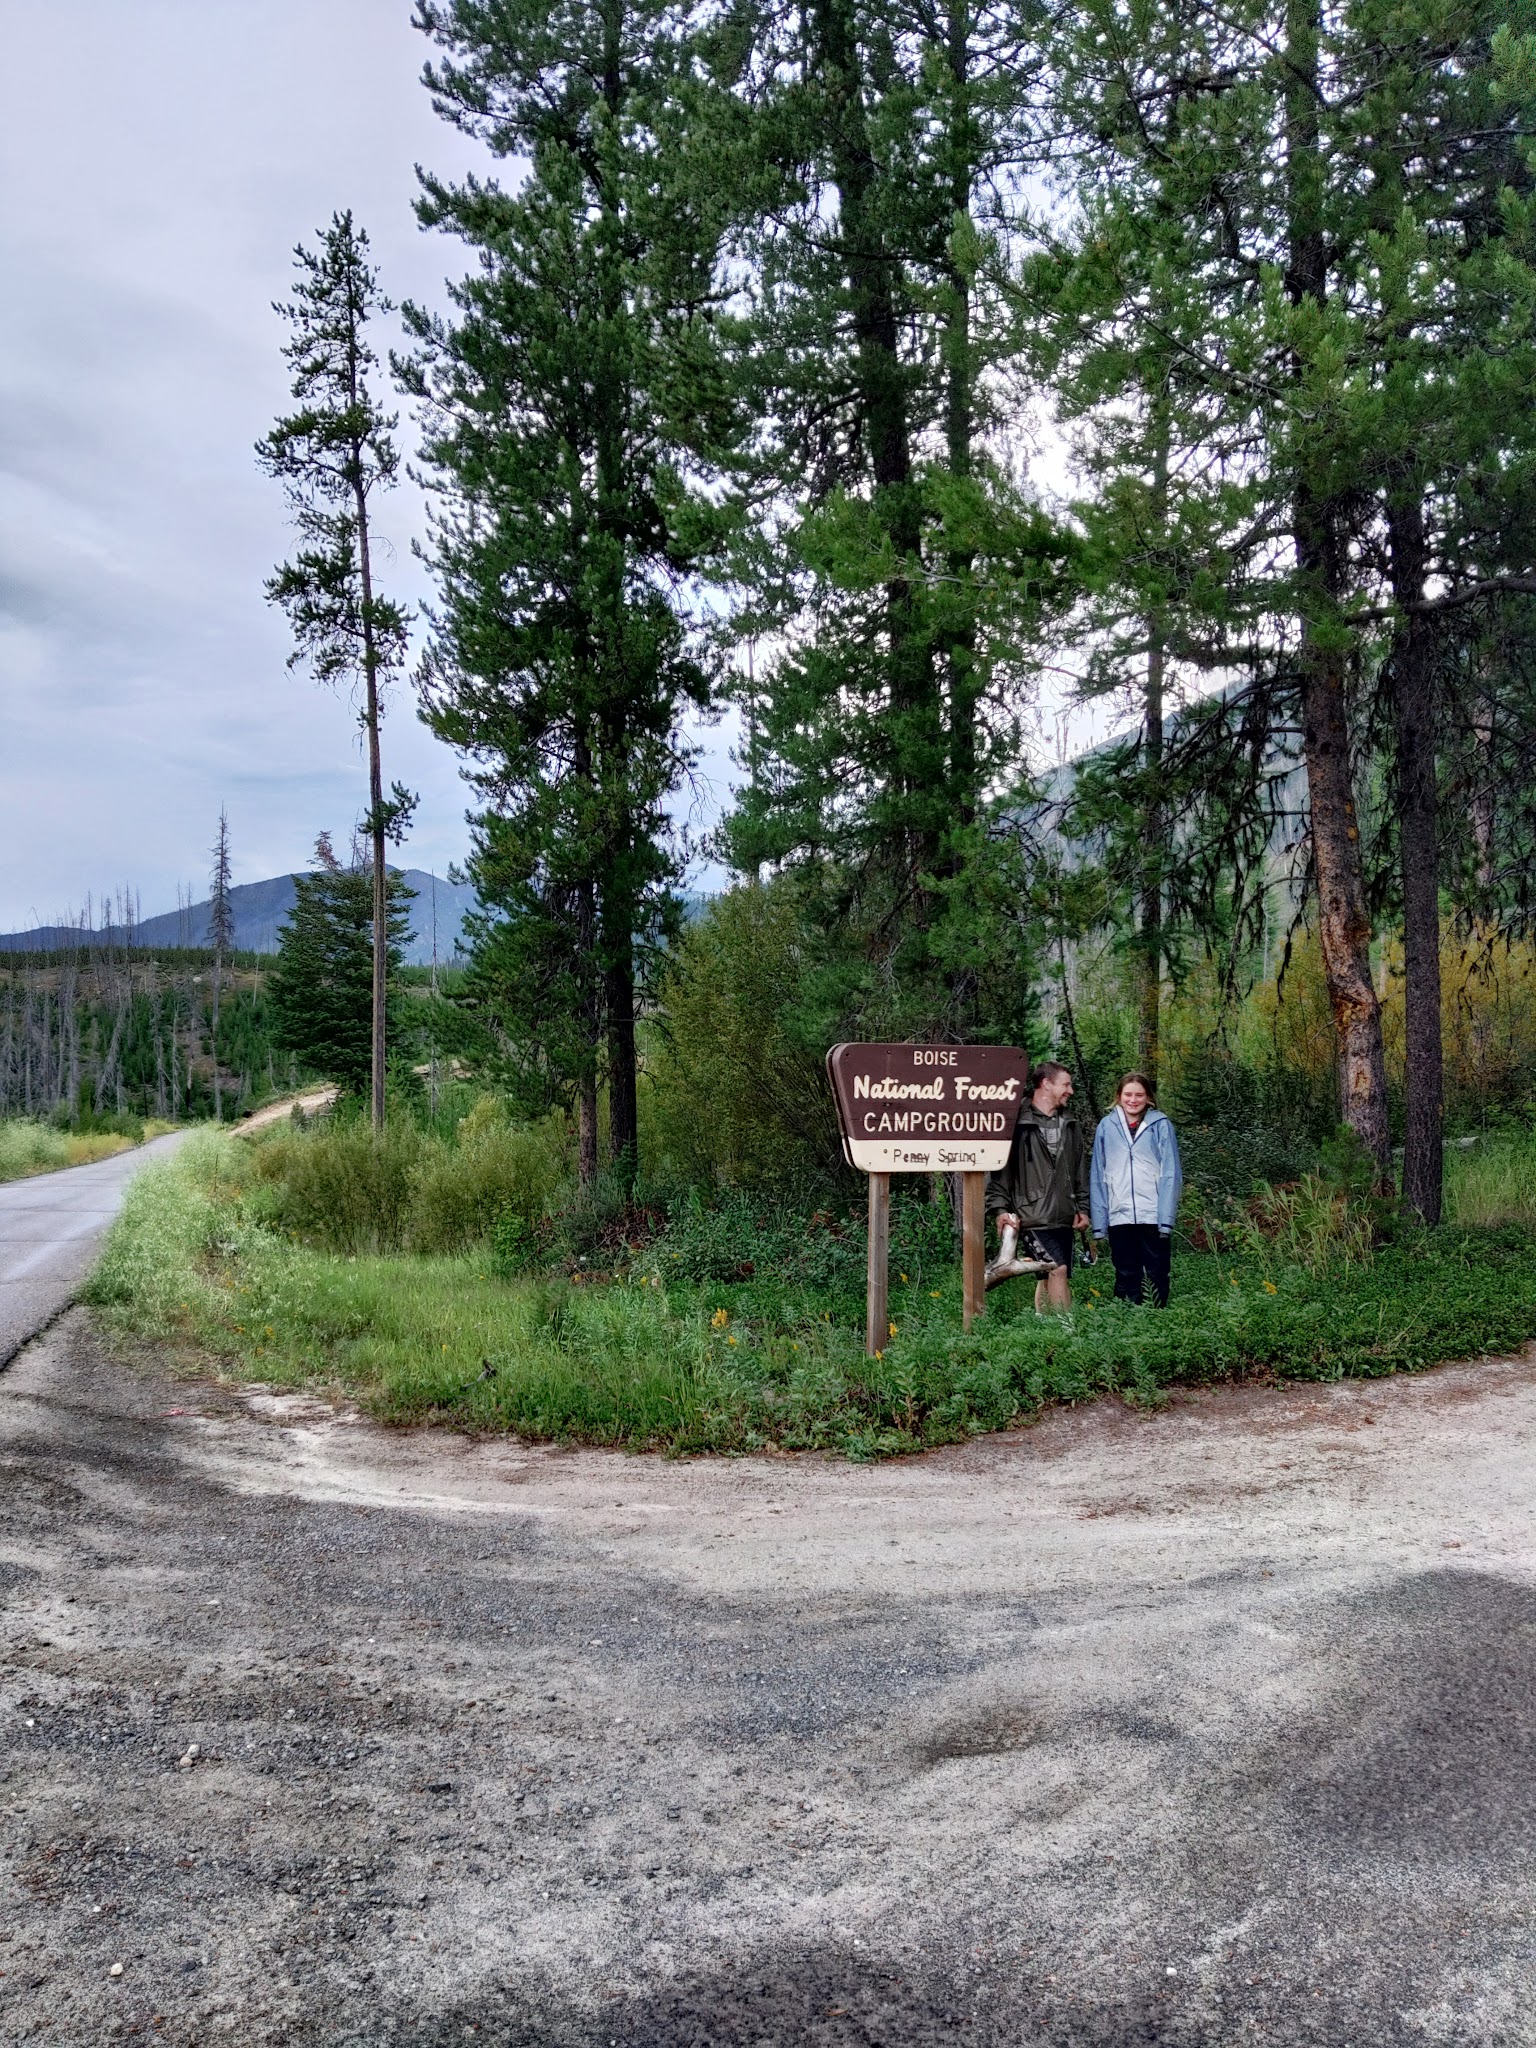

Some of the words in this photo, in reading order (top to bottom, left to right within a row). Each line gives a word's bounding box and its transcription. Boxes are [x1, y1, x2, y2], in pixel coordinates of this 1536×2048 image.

[913, 1051, 958, 1066] BOISE
[853, 1074, 945, 1101] National
[953, 1076, 1020, 1101] Forest
[863, 1111, 1006, 1133] CAMPGROUND
[938, 1148, 976, 1166] Spring
